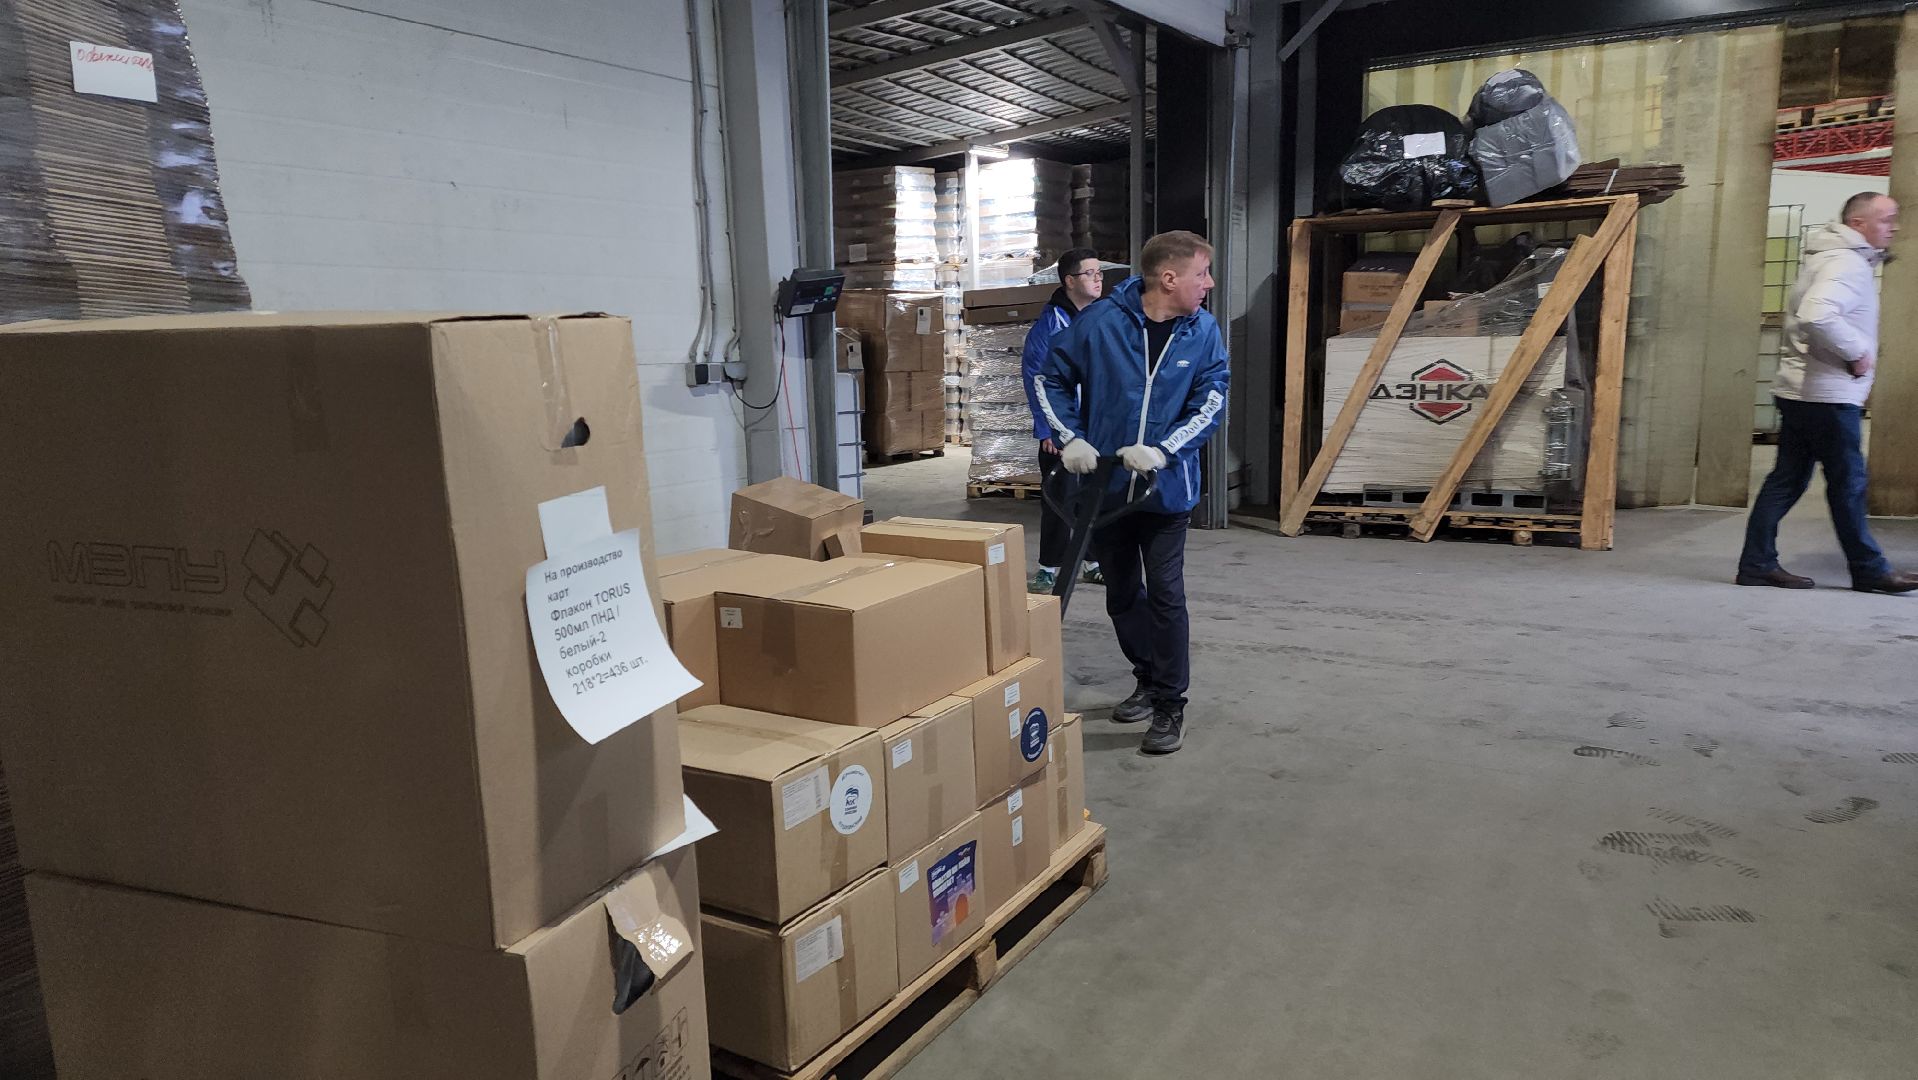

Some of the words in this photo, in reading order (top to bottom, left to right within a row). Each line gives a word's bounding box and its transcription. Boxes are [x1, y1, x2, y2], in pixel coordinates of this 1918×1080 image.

[544, 570, 558, 583] На
[560, 549, 623, 579] производство
[547, 587, 569, 603] карт
[550, 600, 592, 622] Флакон
[594, 582, 631, 605] TORUS
[554, 620, 590, 641] 500мл
[591, 608, 615, 627] ПНД
[559, 631, 607, 660] белый-2
[565, 651, 612, 679] коробки
[629, 656, 649, 669] шт.
